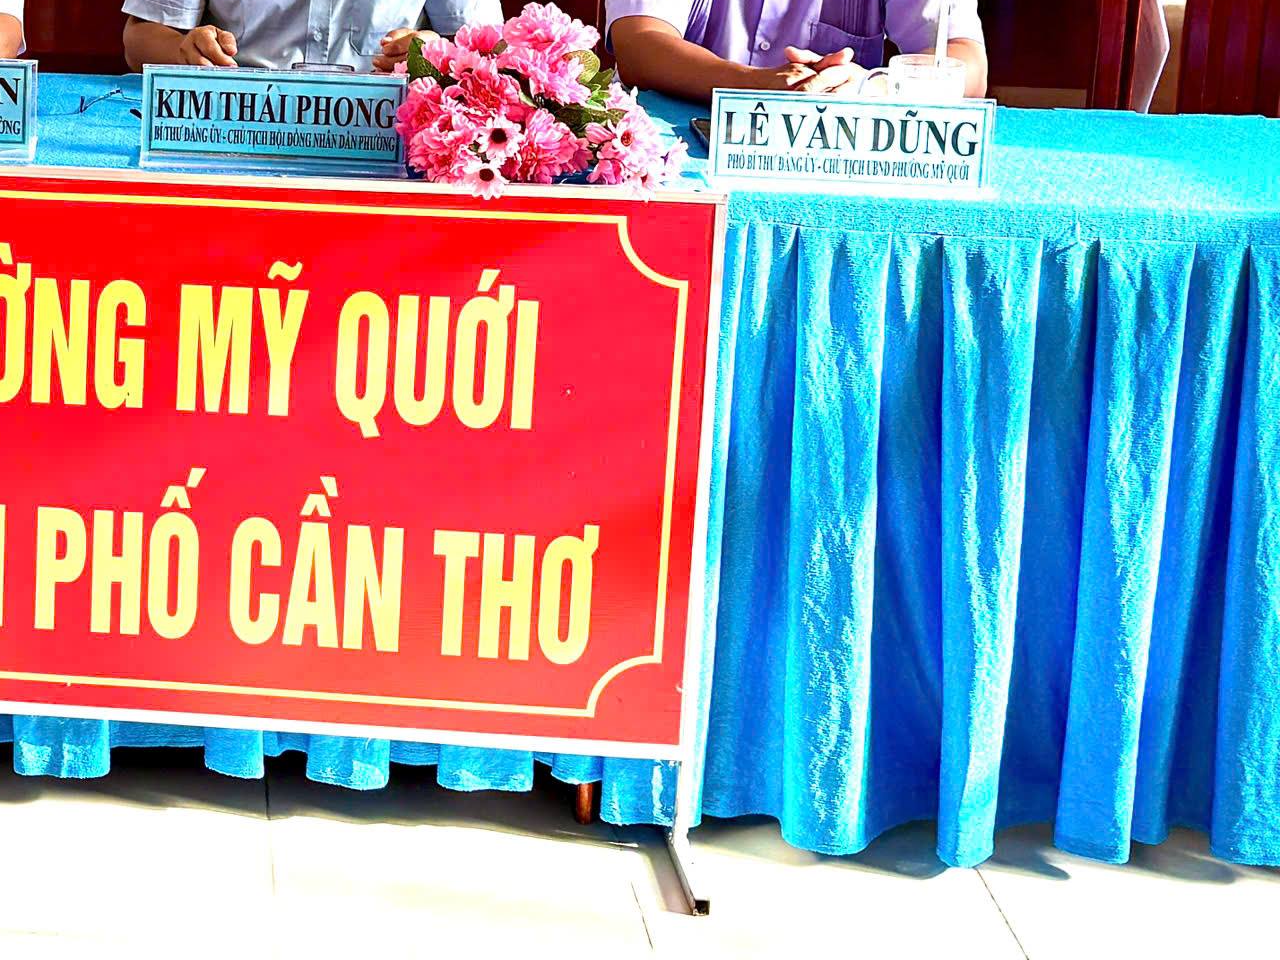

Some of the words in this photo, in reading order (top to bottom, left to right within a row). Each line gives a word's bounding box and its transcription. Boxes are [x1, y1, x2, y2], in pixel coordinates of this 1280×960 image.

[156, 88, 212, 121] KIM
[220, 83, 287, 125] THÁI
[296, 94, 396, 129] PHONG
[722, 101, 770, 146] LÊ
[782, 105, 861, 151] VĂN
[870, 109, 979, 157] DŨNG
[164, 124, 184, 142] THƯ
[247, 129, 268, 149] TỊCH
[358, 131, 396, 152] PHƯỜNG
[867, 159, 890, 177] UBND
[892, 158, 929, 179] PHƯỜNG
[176, 261, 309, 417] MỸ
[334, 268, 539, 438] QUỚI
[34, 467, 207, 640] PHỐ
[228, 476, 404, 653] CẦN
[432, 525, 600, 665] THƠ
